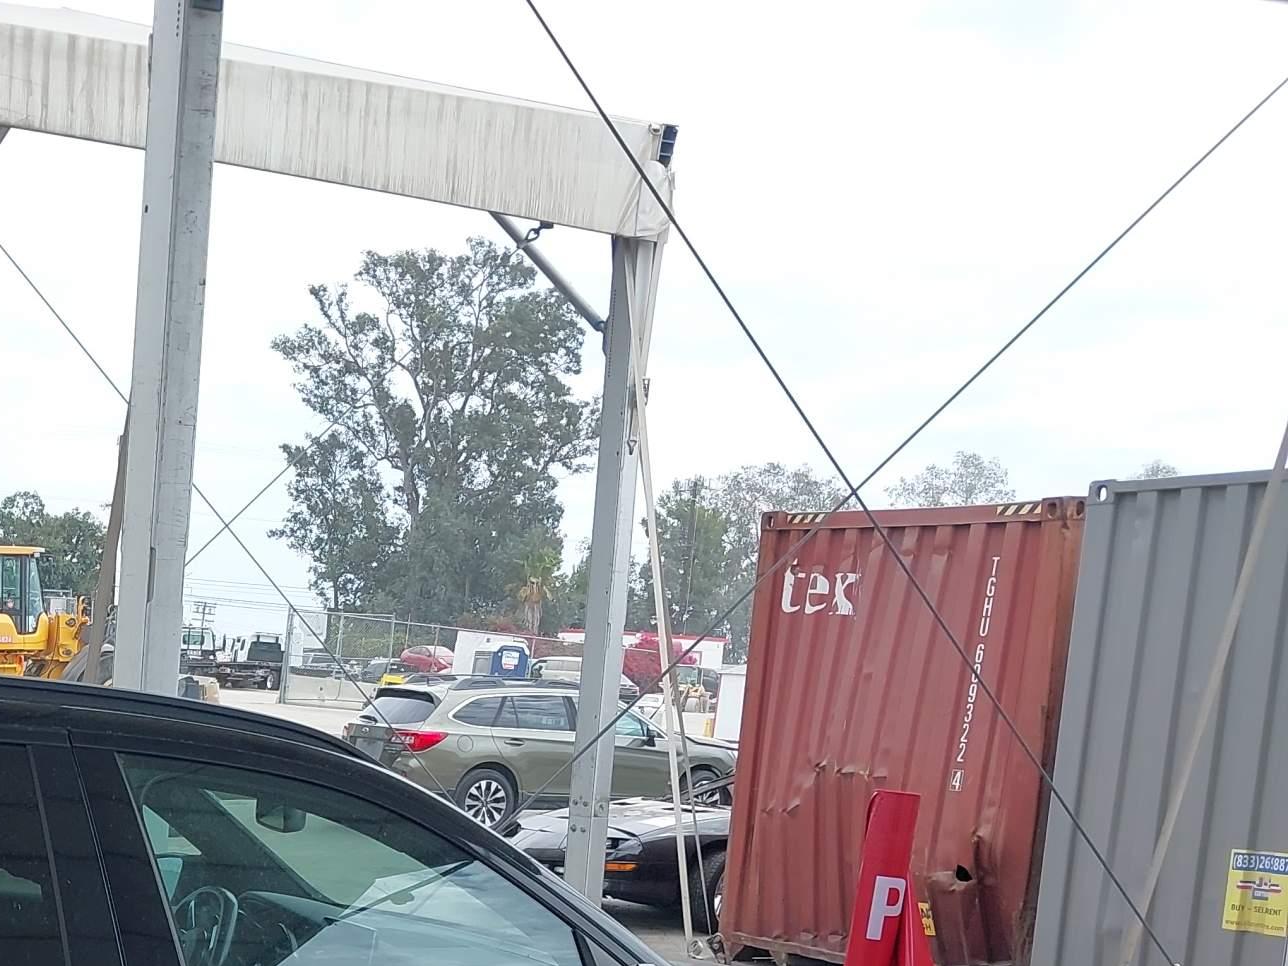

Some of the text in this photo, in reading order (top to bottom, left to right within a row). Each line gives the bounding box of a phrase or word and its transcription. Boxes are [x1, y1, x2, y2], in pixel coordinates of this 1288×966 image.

[782, 558, 861, 616] tex
[979, 556, 1001, 637] TGHU
[866, 875, 906, 940] P
